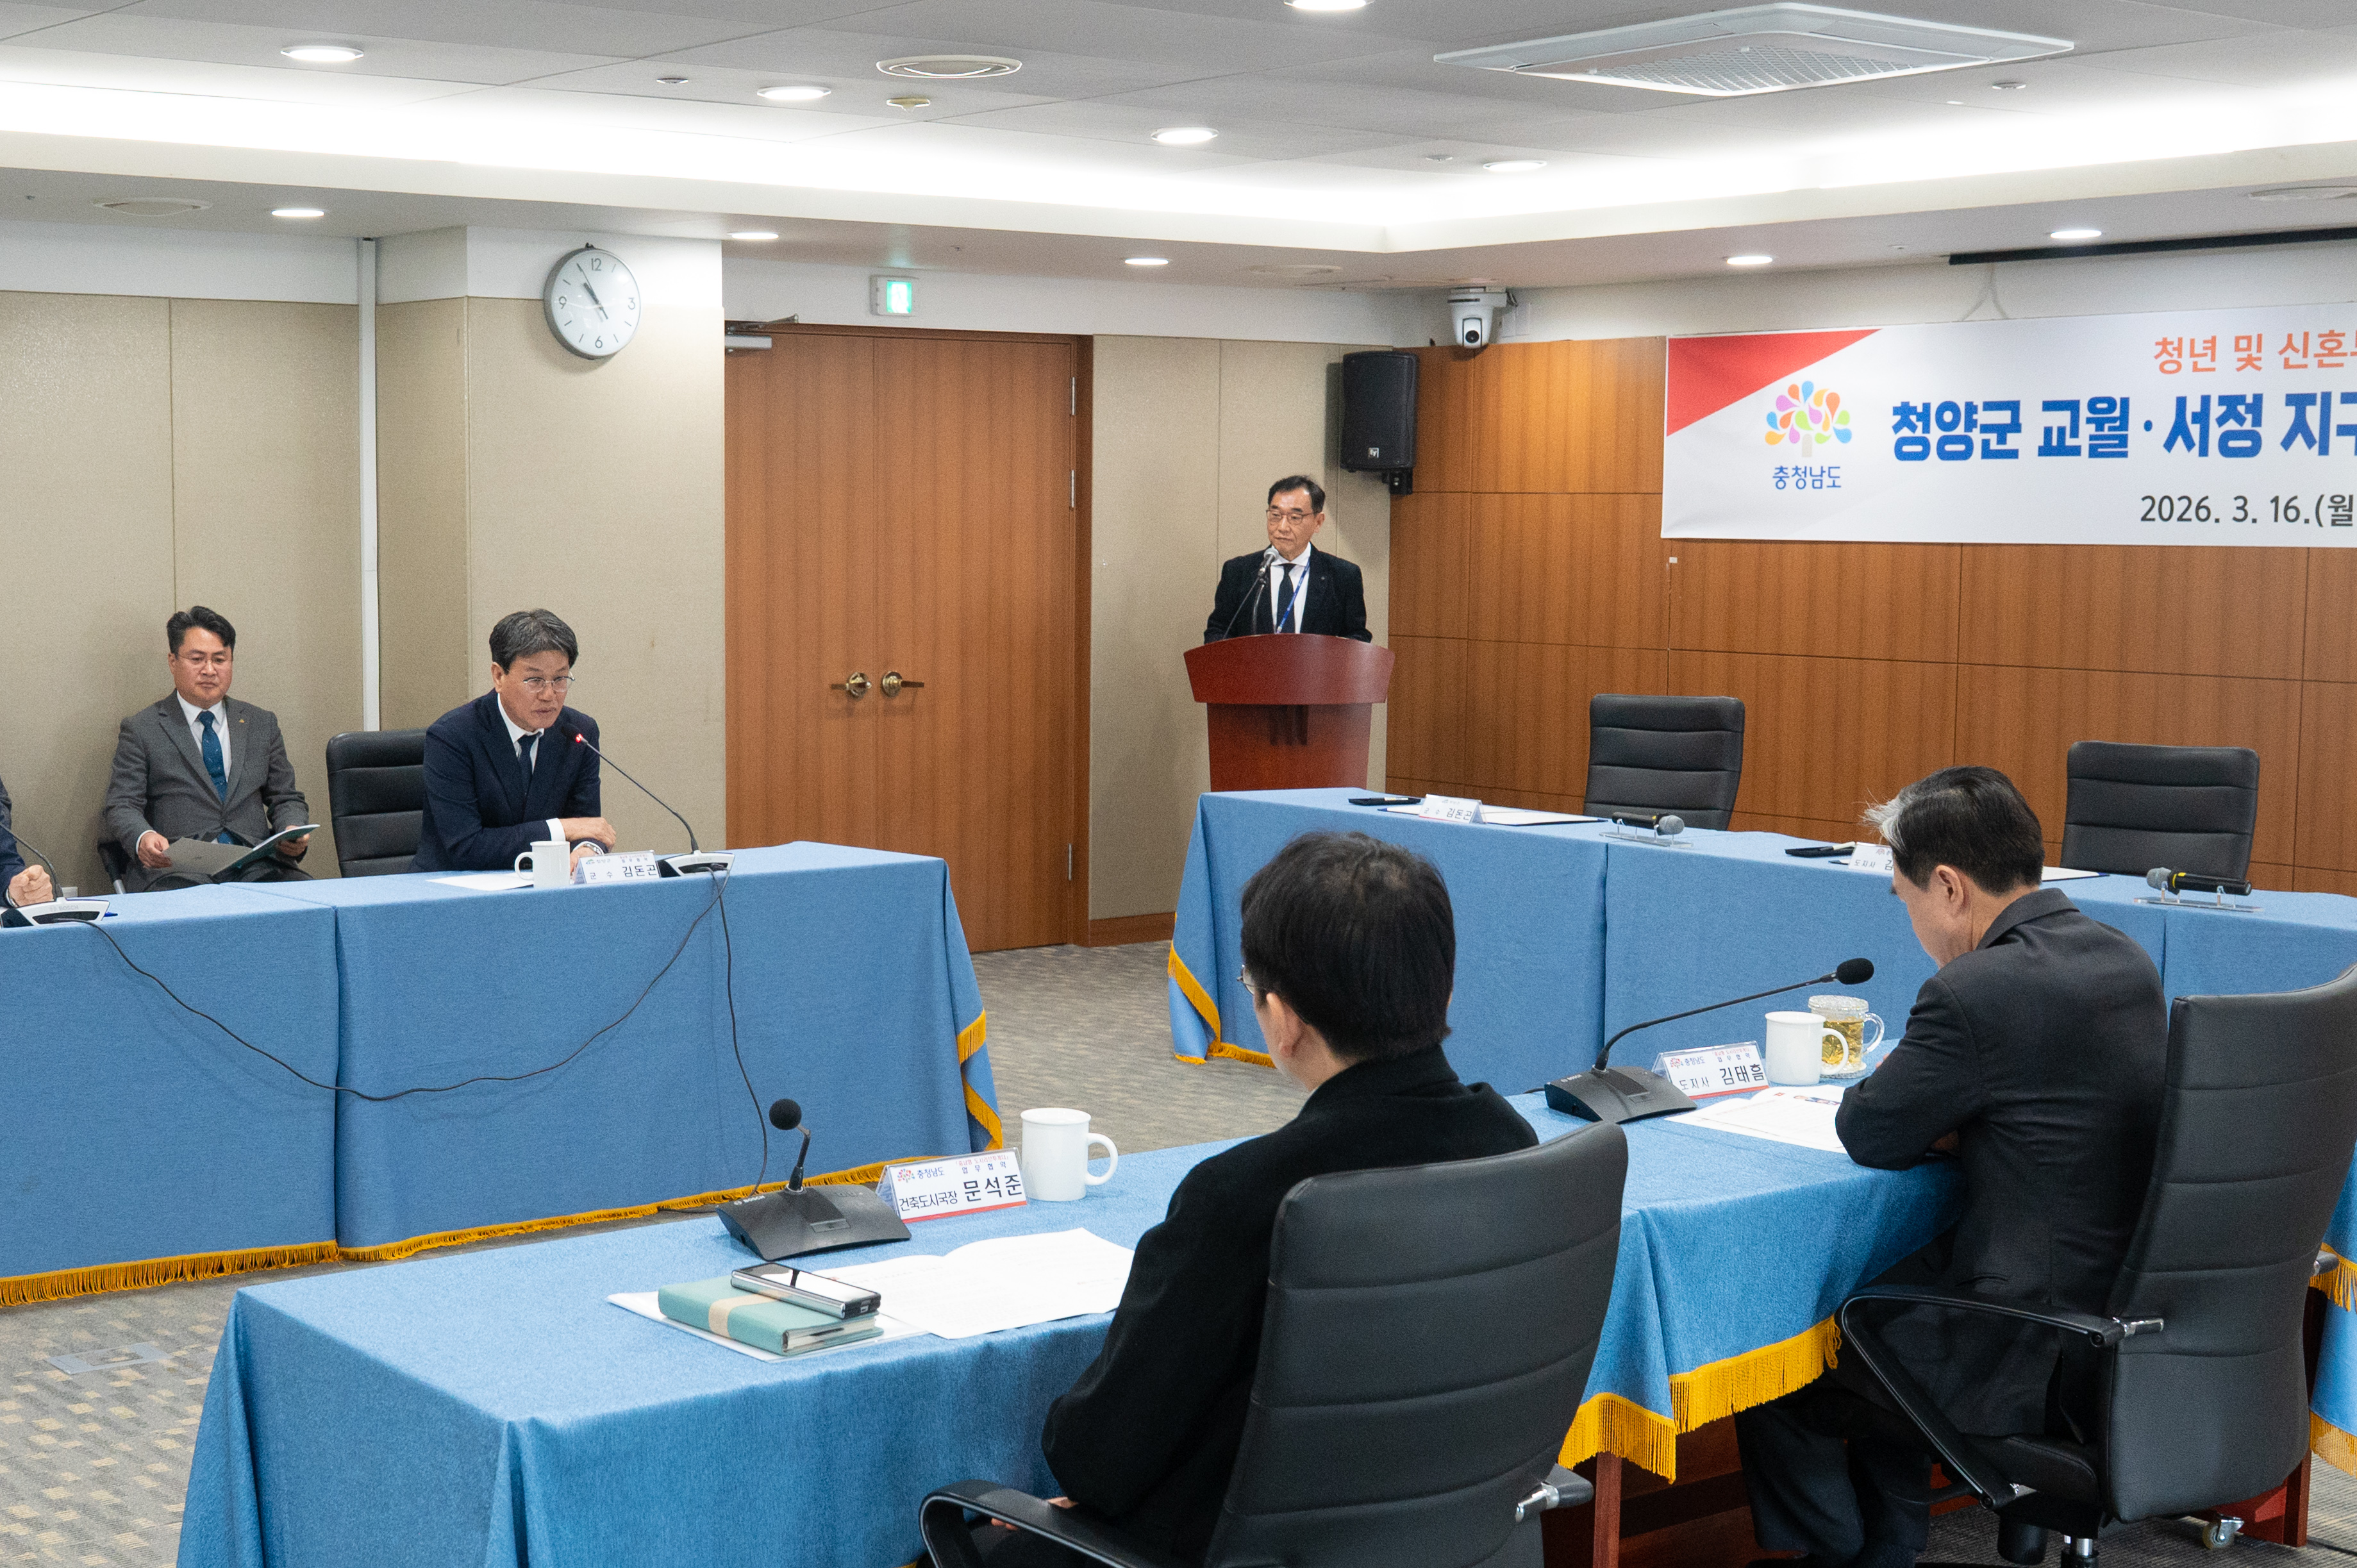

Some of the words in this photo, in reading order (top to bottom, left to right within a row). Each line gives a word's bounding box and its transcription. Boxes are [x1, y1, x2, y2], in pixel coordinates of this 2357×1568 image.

[591, 258, 601, 271] 12
[558, 296, 567, 309] 9
[628, 297, 636, 310] 3
[595, 336, 603, 348] 6
[2154, 336, 2217, 374] 청년
[2234, 333, 2263, 371] 및
[1892, 400, 2022, 462] 청양군
[1772, 465, 1841, 490] 충청남도
[2140, 495, 2220, 523] 2026.
[2232, 496, 2257, 523] 3.
[622, 864, 657, 878] 김돈곤
[1719, 1063, 1764, 1085] 김태흠
[917, 1166, 945, 1180] 충청남도
[899, 1190, 958, 1212] 건축도시국장
[963, 1174, 1023, 1203] 문석준
